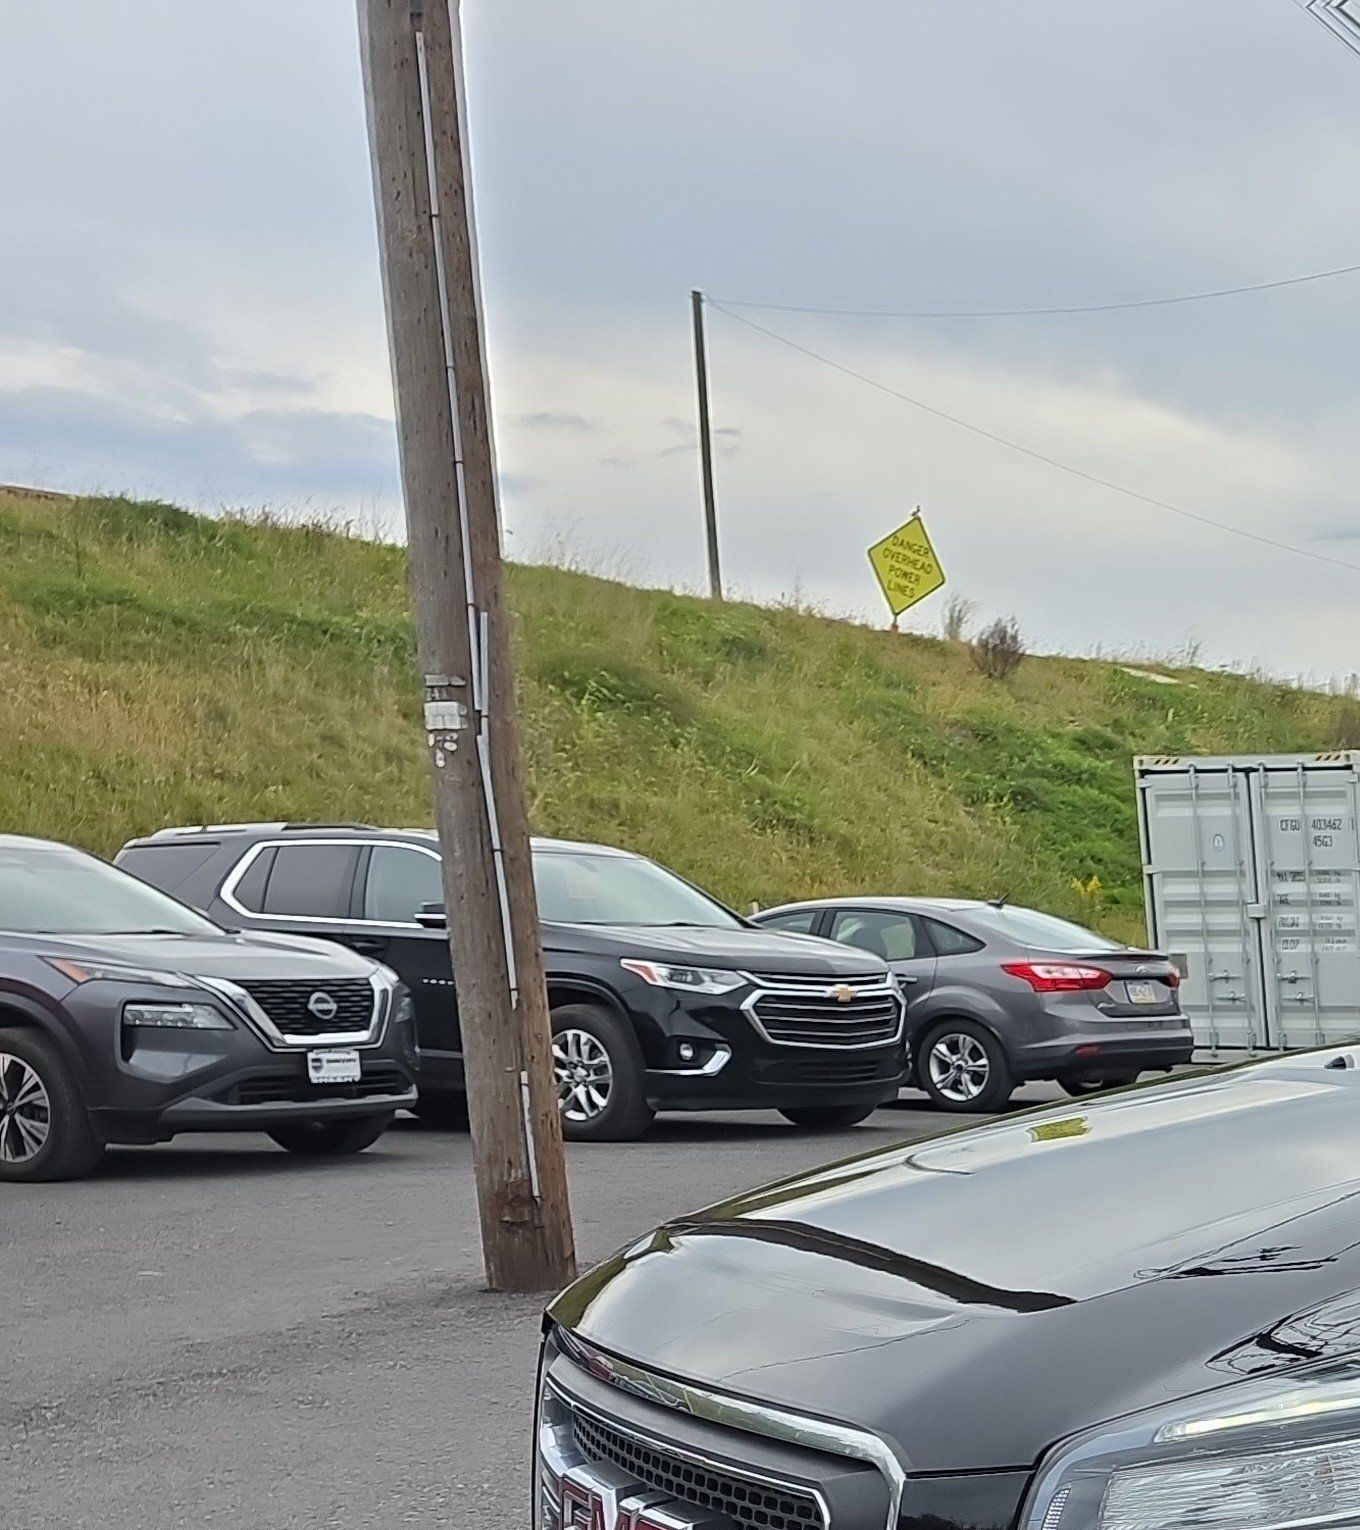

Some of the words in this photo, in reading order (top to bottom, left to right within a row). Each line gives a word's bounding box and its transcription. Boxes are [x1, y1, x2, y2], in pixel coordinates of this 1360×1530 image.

[891, 535, 930, 557] DANGER
[882, 547, 933, 574] OVERHEAD
[888, 564, 921, 584] POWER
[887, 578, 915, 598] LINES
